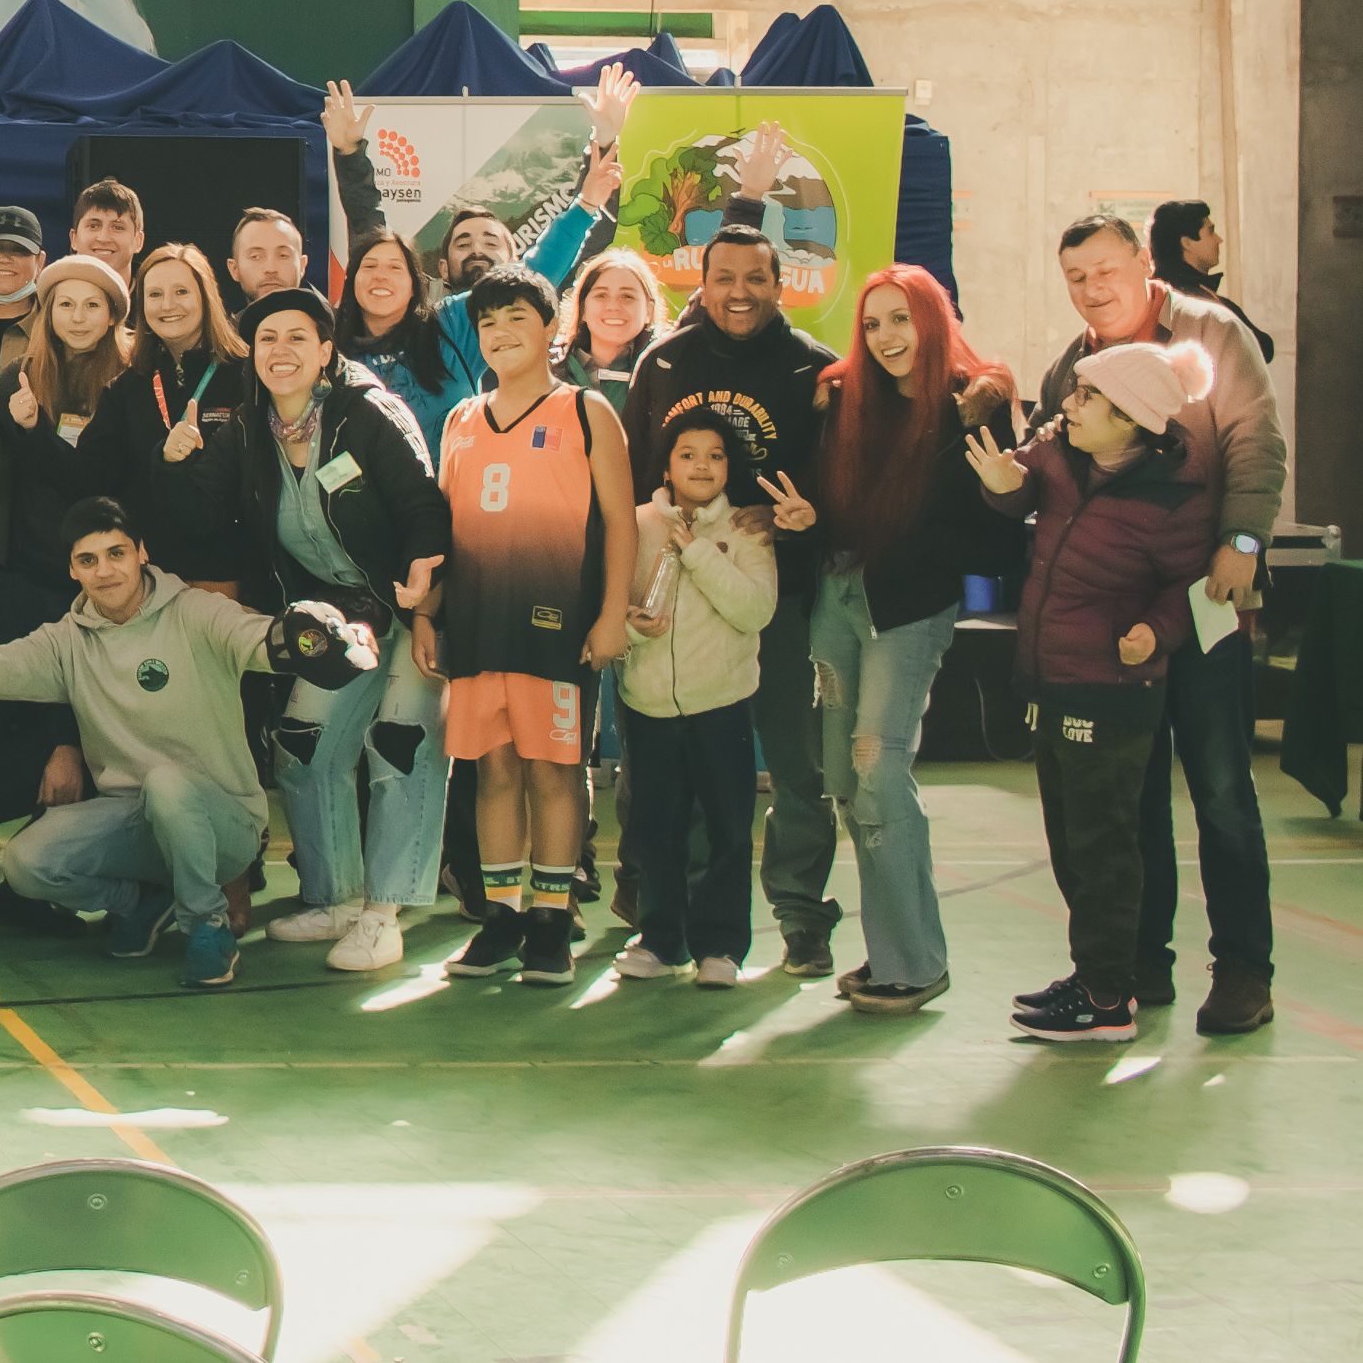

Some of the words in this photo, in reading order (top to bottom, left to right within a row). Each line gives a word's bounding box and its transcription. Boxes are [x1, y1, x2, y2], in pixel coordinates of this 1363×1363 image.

[512, 181, 576, 255] URISMO
[673, 247, 704, 271] RU
[781, 268, 825, 294] GUA
[662, 392, 703, 428] OMFORT
[708, 391, 731, 403] AND
[733, 392, 778, 440] DURABILITY
[480, 462, 511, 512] 8
[553, 680, 576, 729] 9
[1062, 726, 1093, 743] LOVE
